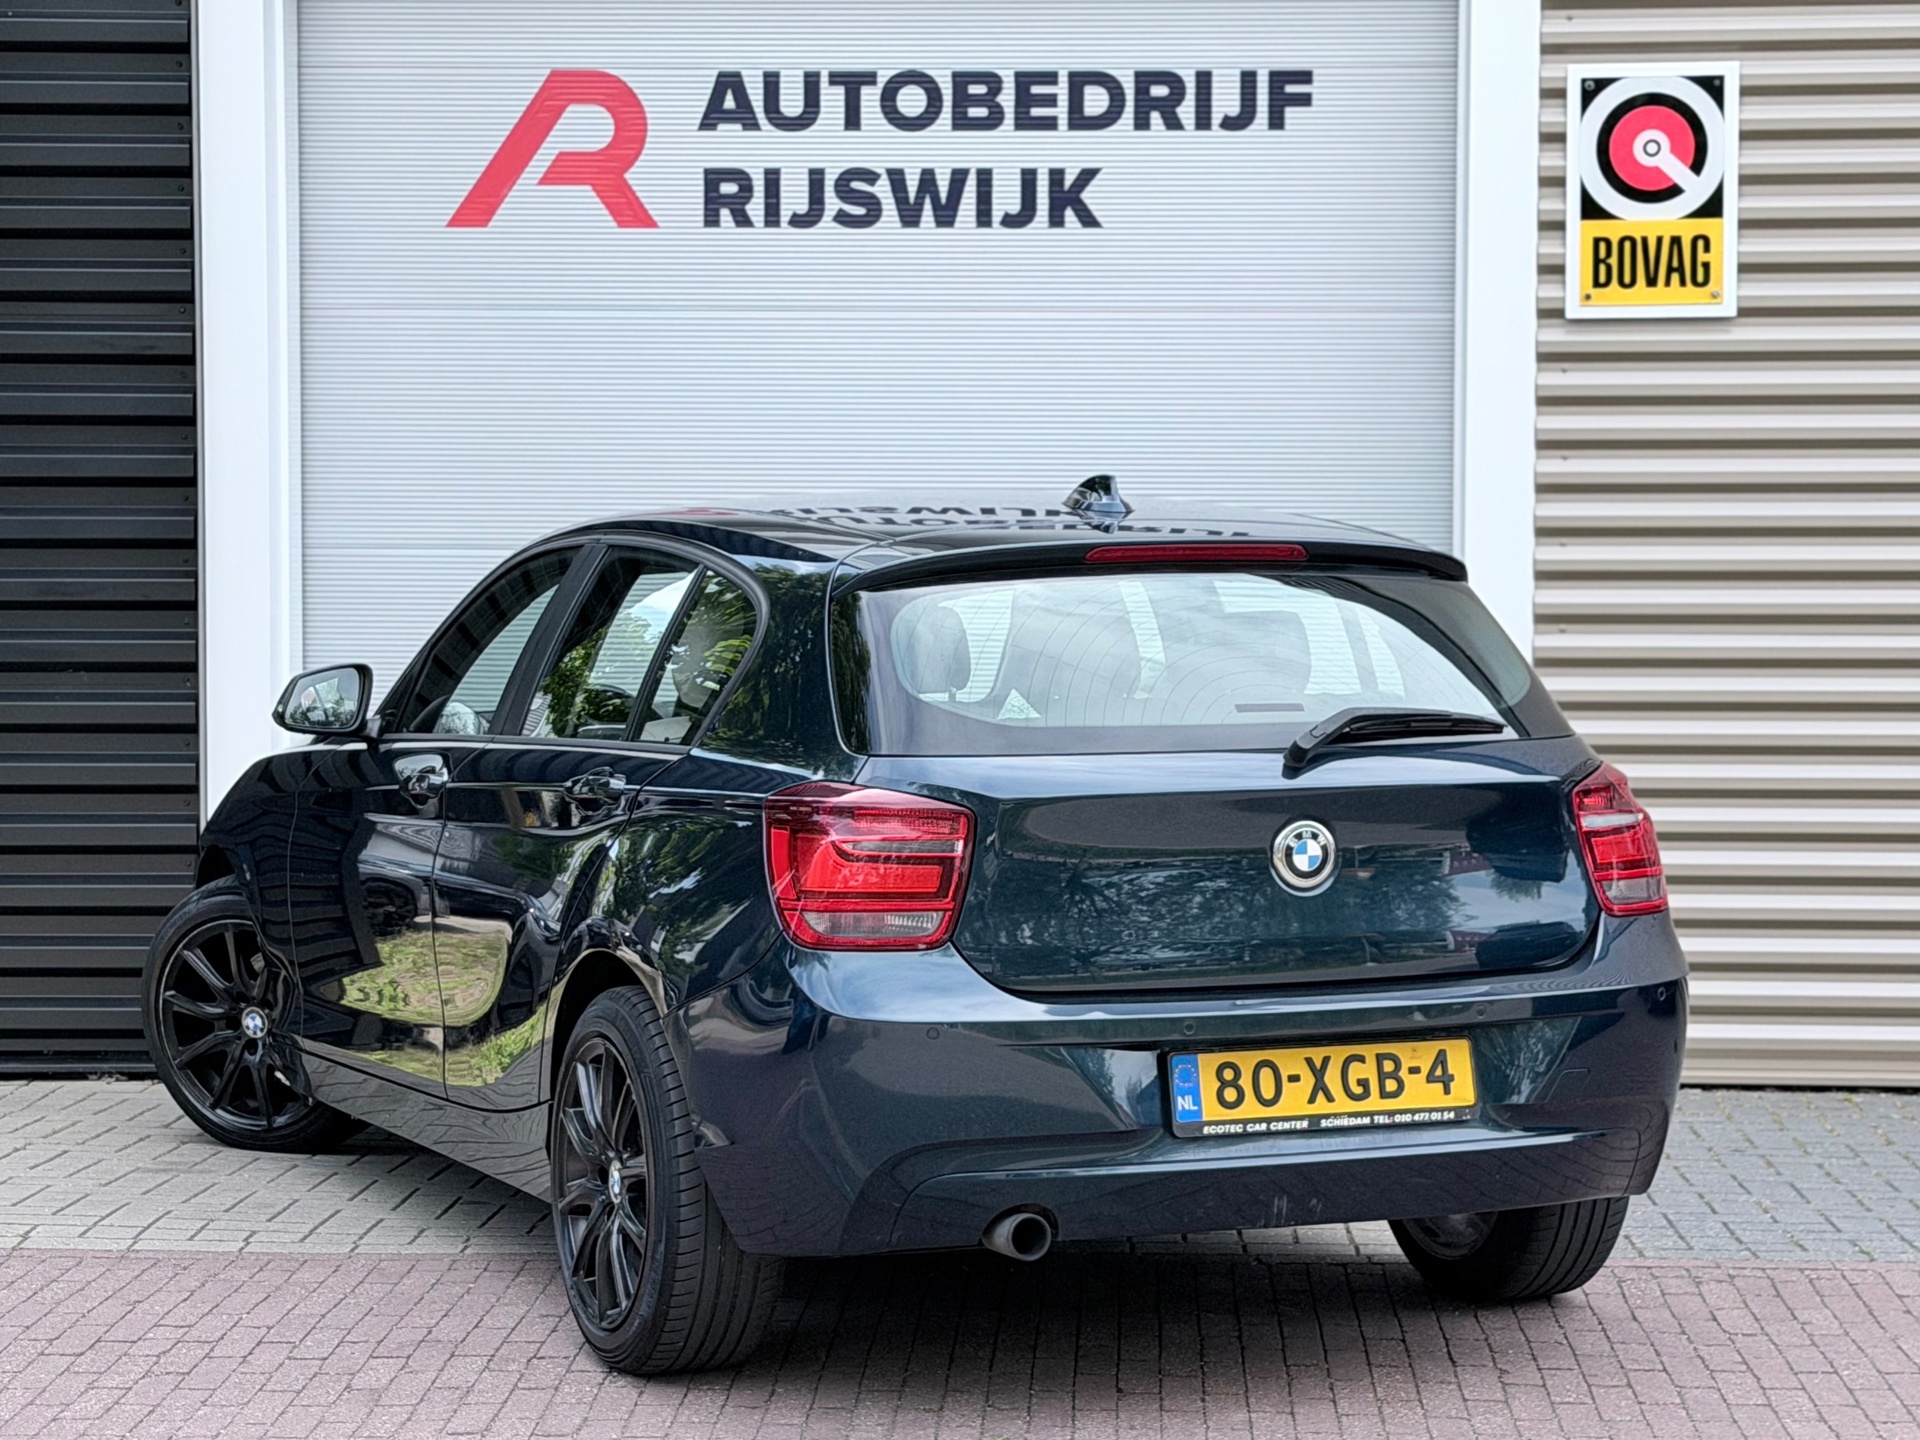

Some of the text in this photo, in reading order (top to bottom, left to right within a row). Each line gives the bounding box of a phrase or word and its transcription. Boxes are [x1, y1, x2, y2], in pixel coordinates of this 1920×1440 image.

[699, 70, 1313, 131] AUTOBEDRIJF
[703, 168, 1102, 228] RIJSWIJK
[1592, 234, 1711, 289] BOVAG
[1177, 1095, 1198, 1111] NL
[1215, 1048, 1455, 1110] 80-XGB-4
[1203, 1124, 1244, 1135] ECOTEC
[1246, 1122, 1268, 1132] CAR
[1270, 1120, 1309, 1131] CENTER
[1320, 1115, 1371, 1128] SCHIEDAM
